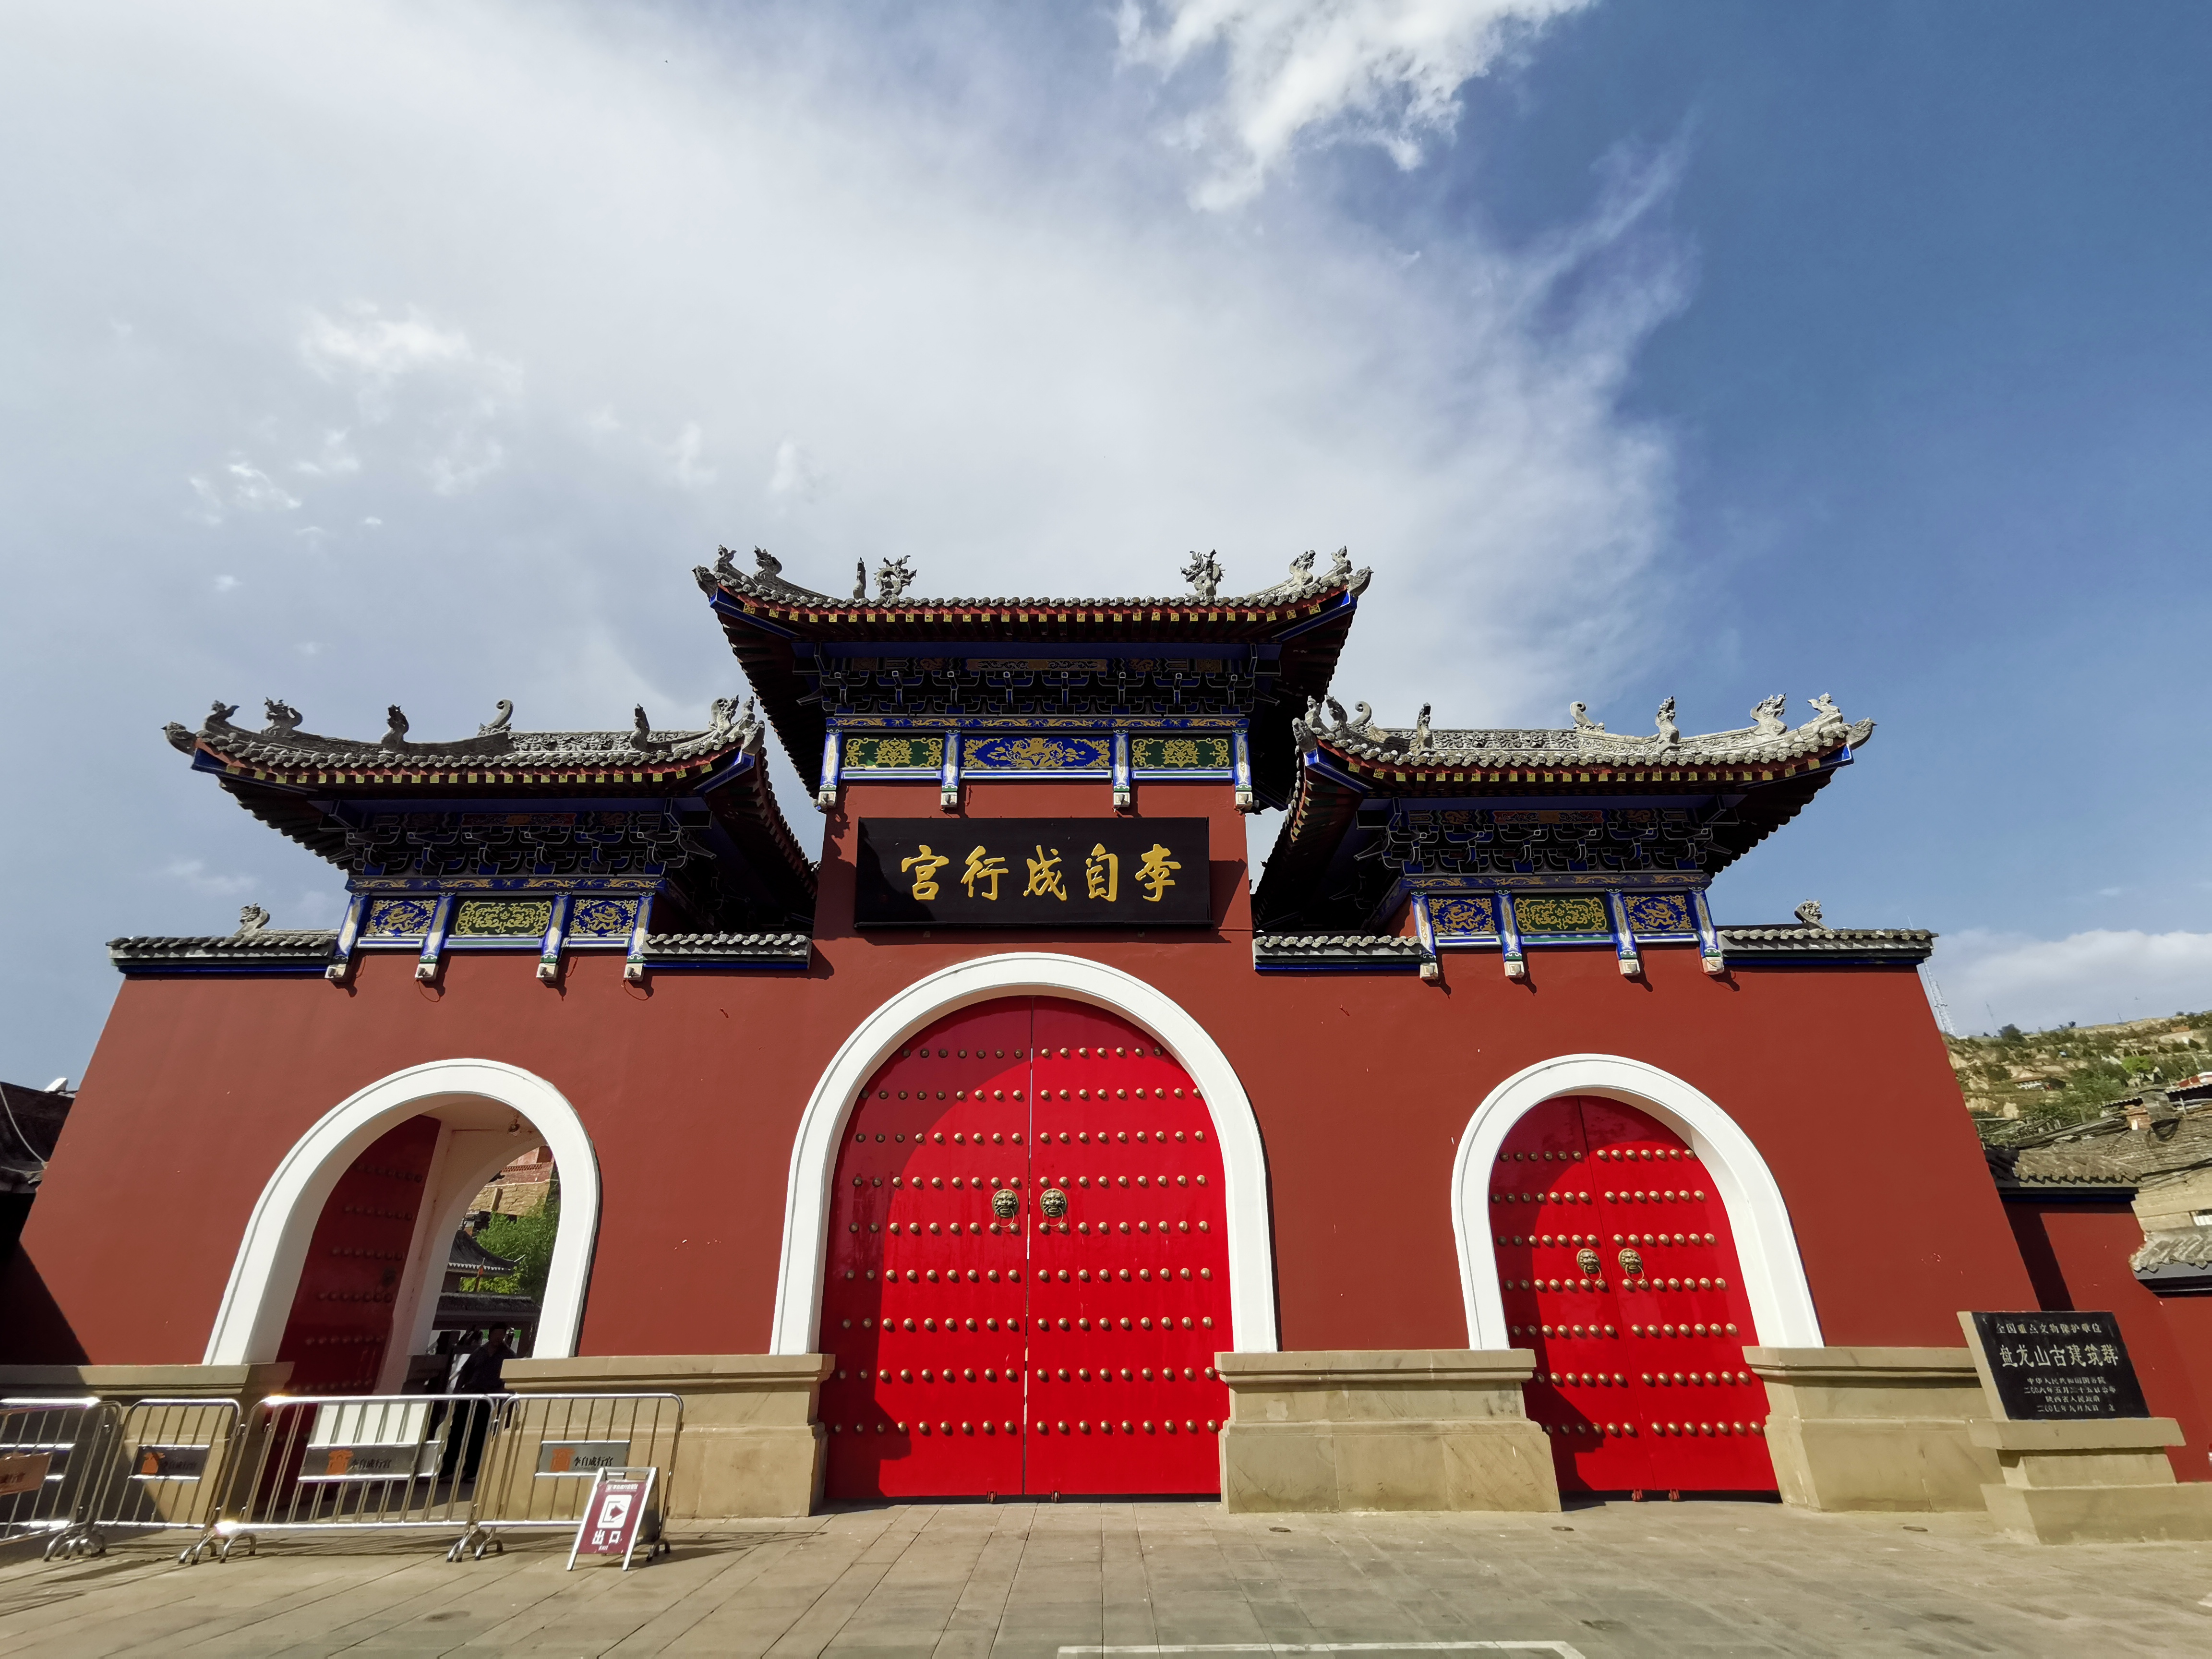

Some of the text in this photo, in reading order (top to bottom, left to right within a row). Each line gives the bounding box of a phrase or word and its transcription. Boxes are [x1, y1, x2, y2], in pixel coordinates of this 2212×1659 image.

[1996, 1322, 2102, 1334] 全国重点文物保护单位
[1999, 1343, 2118, 1368] 盘龙山古建筑群
[591, 1529, 621, 1545] 出口
